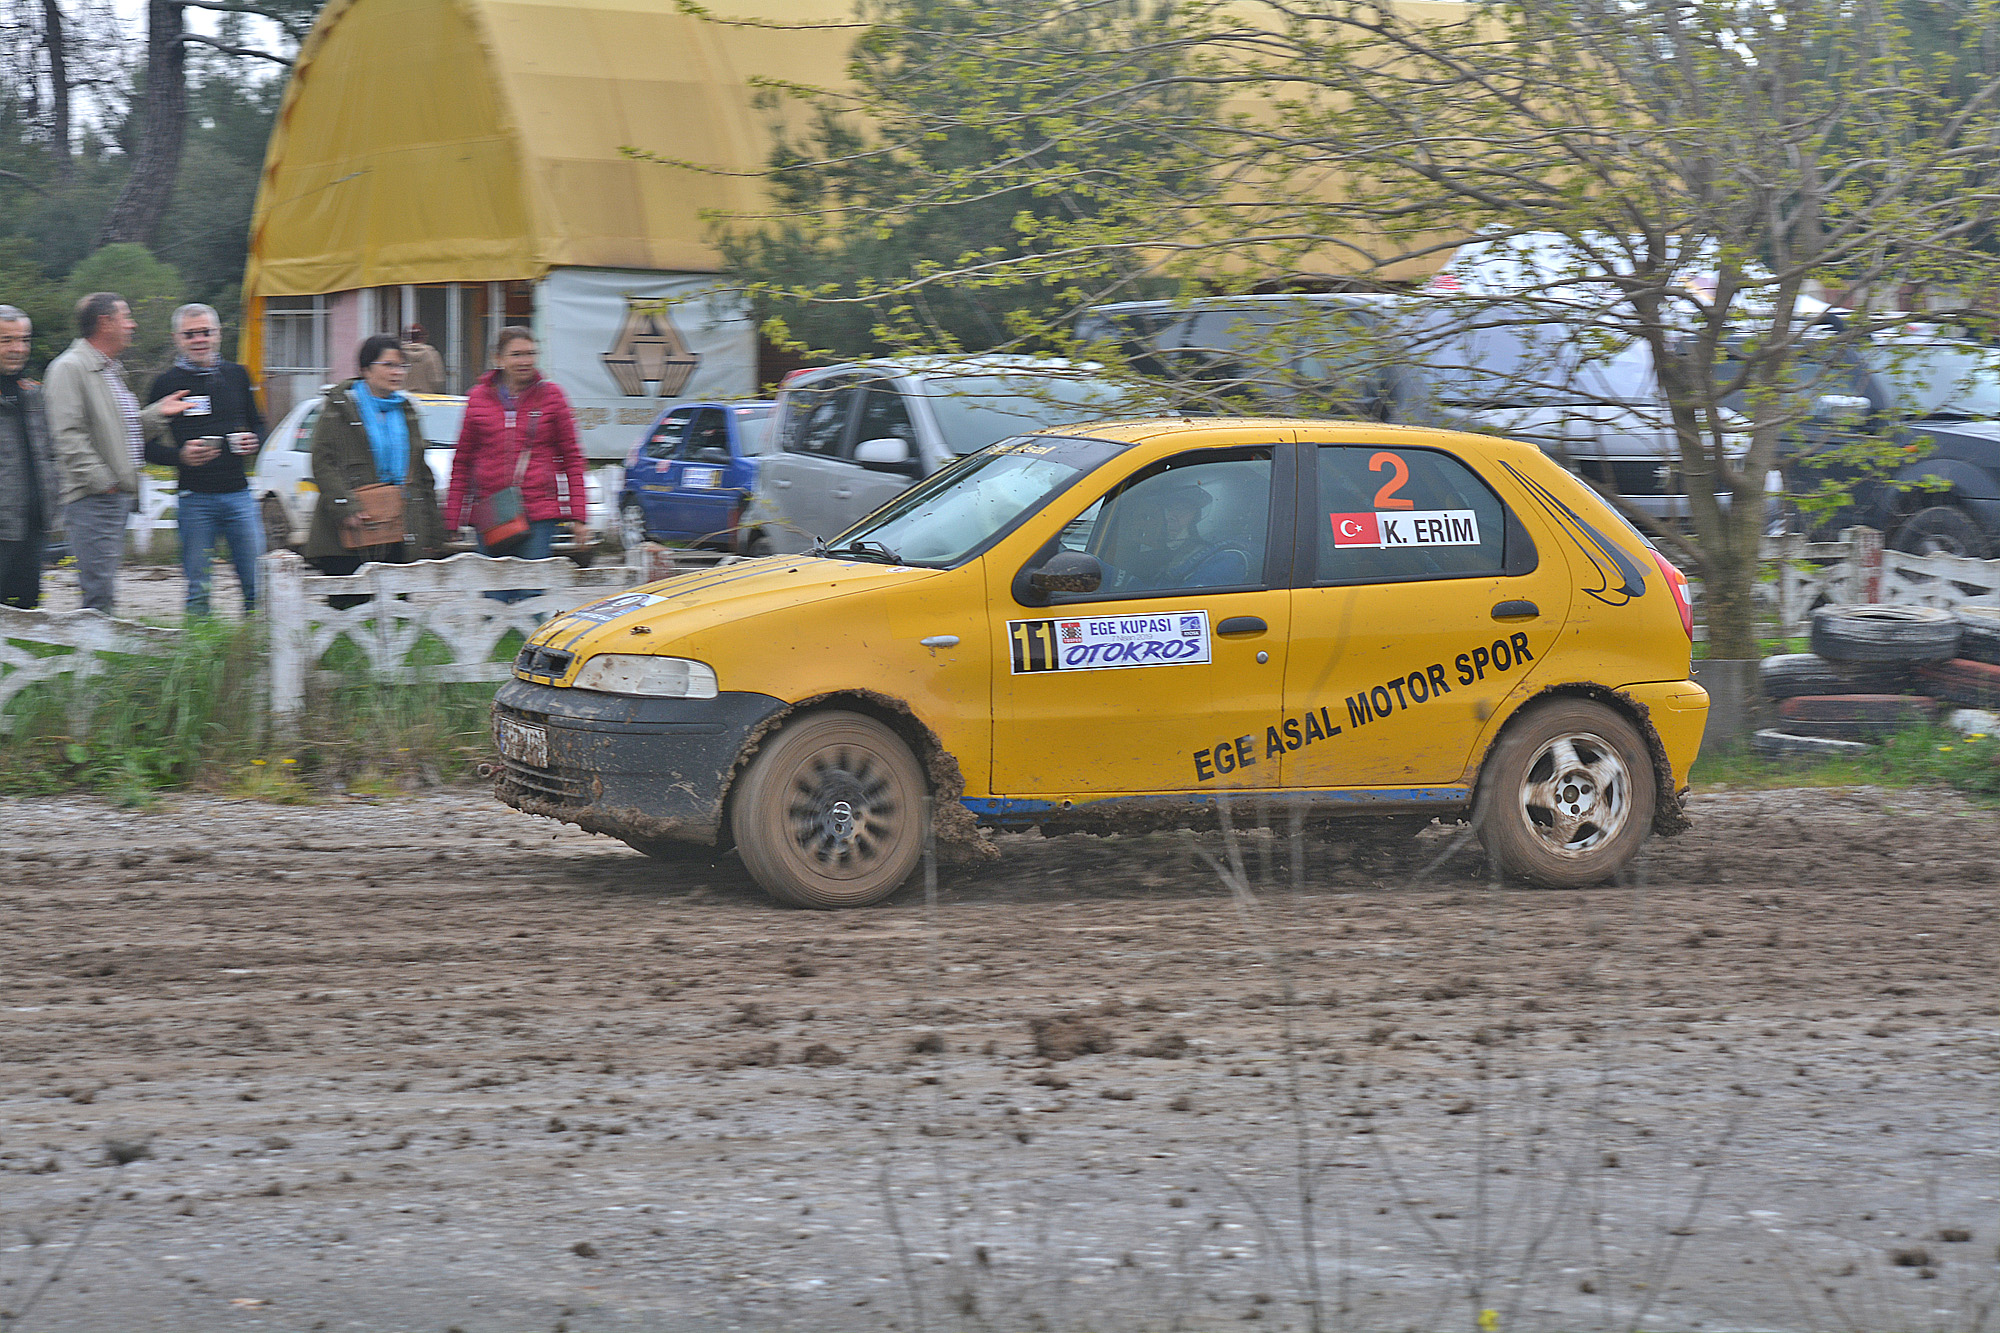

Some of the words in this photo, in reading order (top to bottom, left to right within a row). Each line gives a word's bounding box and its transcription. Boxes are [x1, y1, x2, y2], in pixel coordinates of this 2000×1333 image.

[1368, 452, 1414, 510] 2
[1383, 520, 1407, 544] K.
[1413, 513, 1475, 543] ERİM
[1013, 622, 1053, 671] 11
[1090, 621, 1117, 636] EGE
[1120, 618, 1172, 635] KUPASI
[1064, 638, 1202, 665] OTOKROS
[1193, 734, 1257, 782] EGE
[1265, 706, 1342, 759] ASAL
[1345, 663, 1452, 729] MOTOR
[1454, 631, 1535, 686] SPOR
